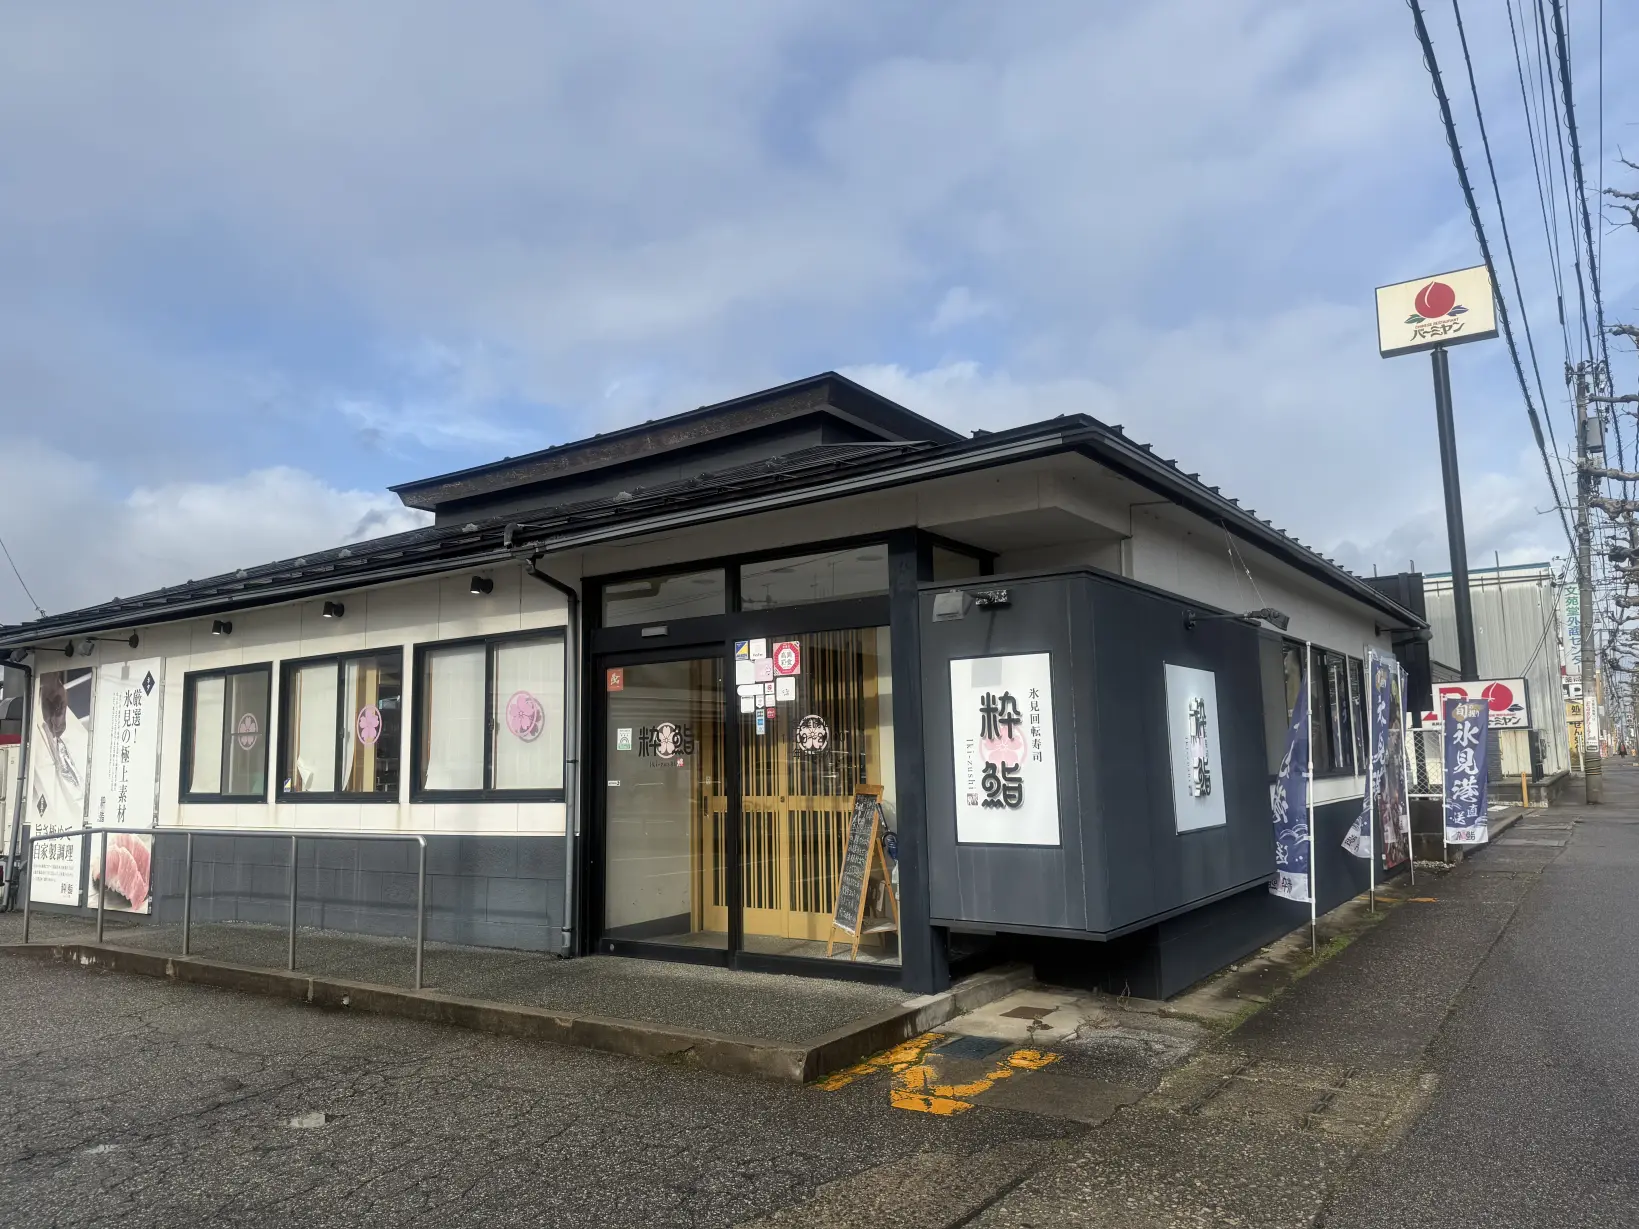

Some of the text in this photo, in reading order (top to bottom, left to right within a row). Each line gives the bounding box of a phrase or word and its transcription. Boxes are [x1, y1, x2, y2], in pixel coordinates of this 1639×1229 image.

[117, 690, 133, 823] 氷見の極上素材
[639, 724, 695, 758] 粋鮨
[979, 691, 1023, 809] 粋鮨
[1029, 687, 1042, 763] 氷見回転寿司
[33, 843, 74, 861] 自家製調理
